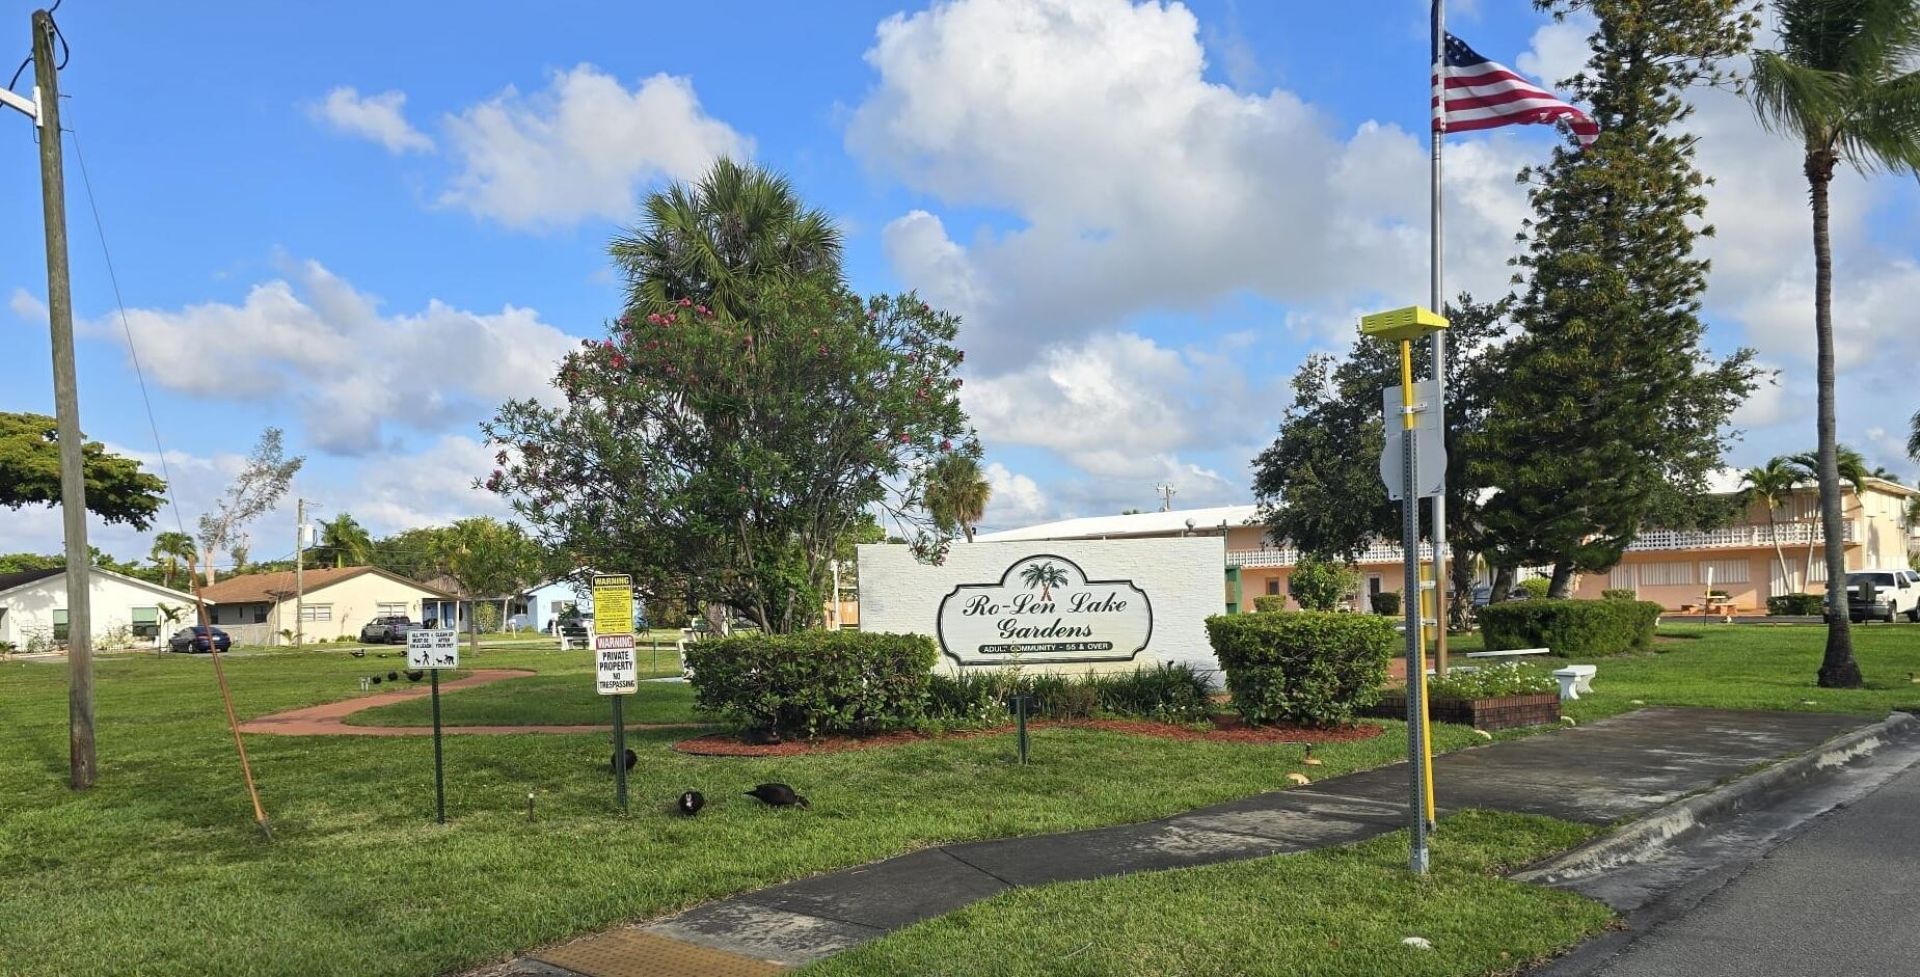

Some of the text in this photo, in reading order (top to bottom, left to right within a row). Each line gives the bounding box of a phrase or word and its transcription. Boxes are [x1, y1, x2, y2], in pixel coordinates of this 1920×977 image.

[594, 576, 630, 586] WARNING
[963, 592, 1128, 617] Ro-Len Lake
[997, 618, 1093, 640] Gardens
[597, 636, 633, 649] WARNING
[1079, 643, 1085, 651] &
[603, 651, 629, 661] PRIVATE
[600, 661, 632, 671] PROPERTY
[613, 672, 621, 680] NO
[599, 680, 635, 689] TRESPASSING
